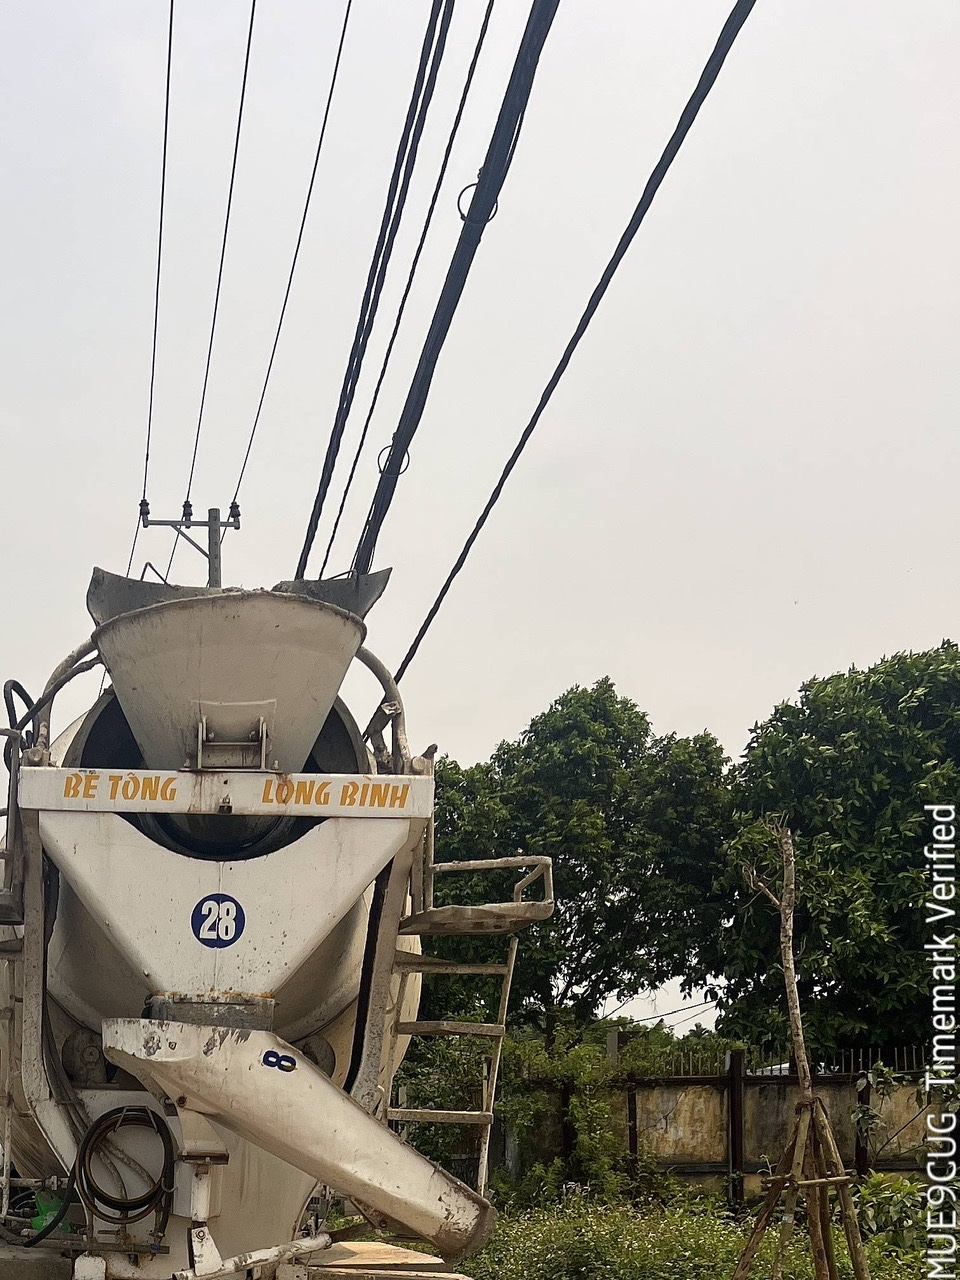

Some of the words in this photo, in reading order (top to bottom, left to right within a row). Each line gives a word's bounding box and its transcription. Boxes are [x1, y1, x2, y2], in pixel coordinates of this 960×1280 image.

[108, 772, 178, 800] TÔNG
[262, 779, 332, 805] LONG
[340, 776, 410, 808] BÌNH
[200, 900, 237, 941] 28
[263, 1050, 297, 1073] 8
